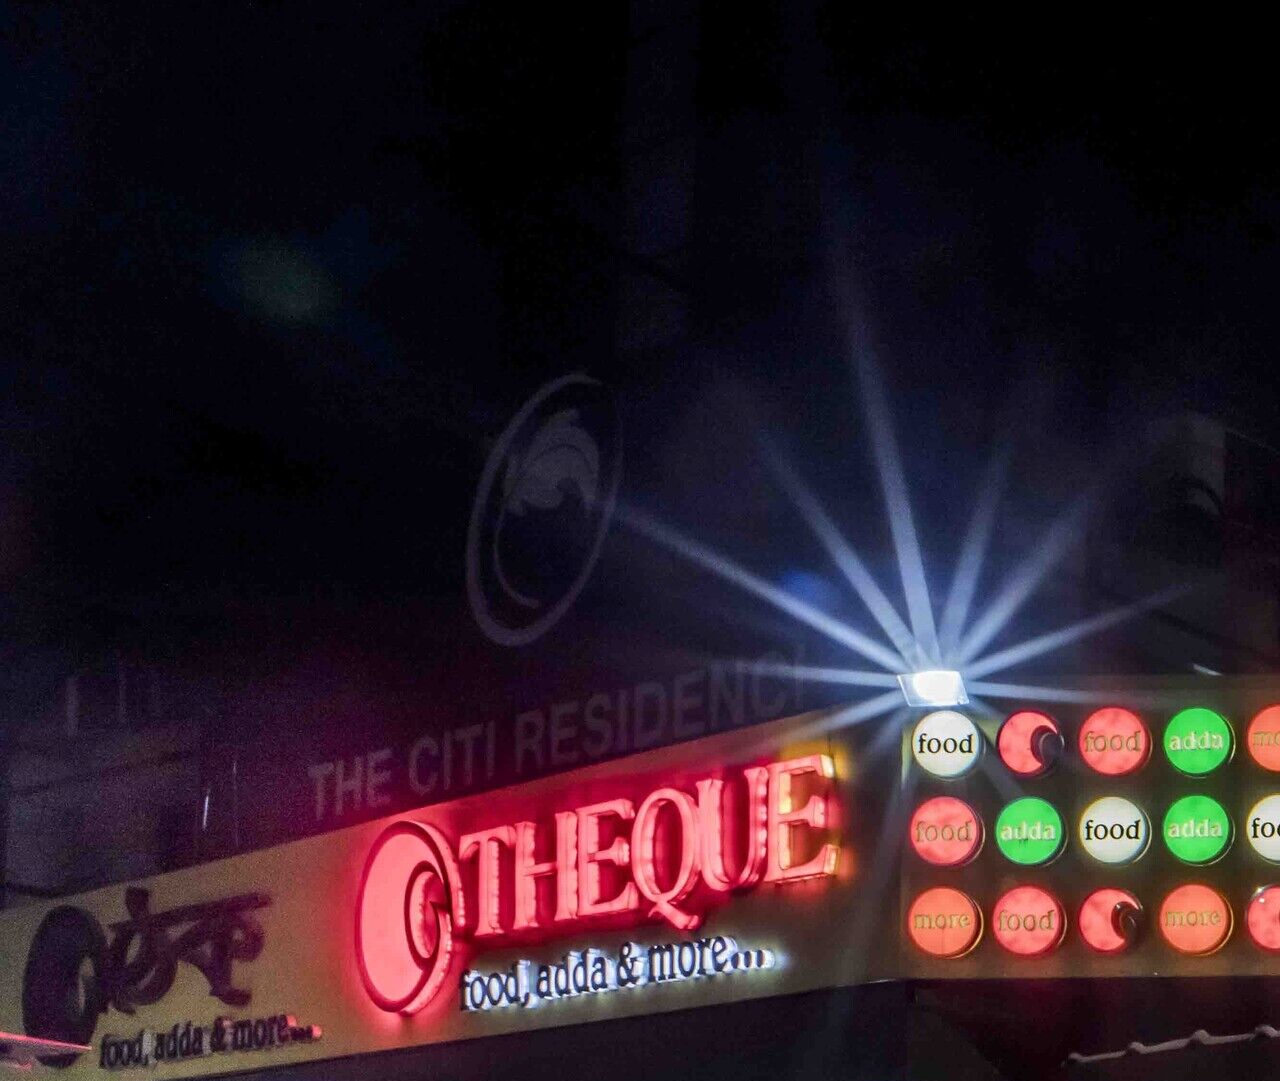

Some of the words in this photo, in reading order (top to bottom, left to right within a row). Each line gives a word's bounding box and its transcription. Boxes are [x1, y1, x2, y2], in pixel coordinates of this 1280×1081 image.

[918, 733, 974, 754] food
[1085, 731, 1141, 752] food
[1168, 731, 1224, 751] adda
[307, 747, 392, 819] THE
[408, 720, 498, 796] CITI
[459, 754, 840, 932] THEQUE
[915, 821, 972, 843] food
[1001, 821, 1056, 841] adda
[1085, 820, 1141, 841] food
[1168, 818, 1222, 838] adda
[914, 912, 971, 930] more
[999, 910, 1055, 932] food
[1165, 911, 1221, 927] more
[460, 960, 539, 1010] food,
[536, 947, 611, 999] adda
[617, 941, 641, 988] &
[156, 1020, 204, 1060] adda
[211, 1016, 234, 1052] &
